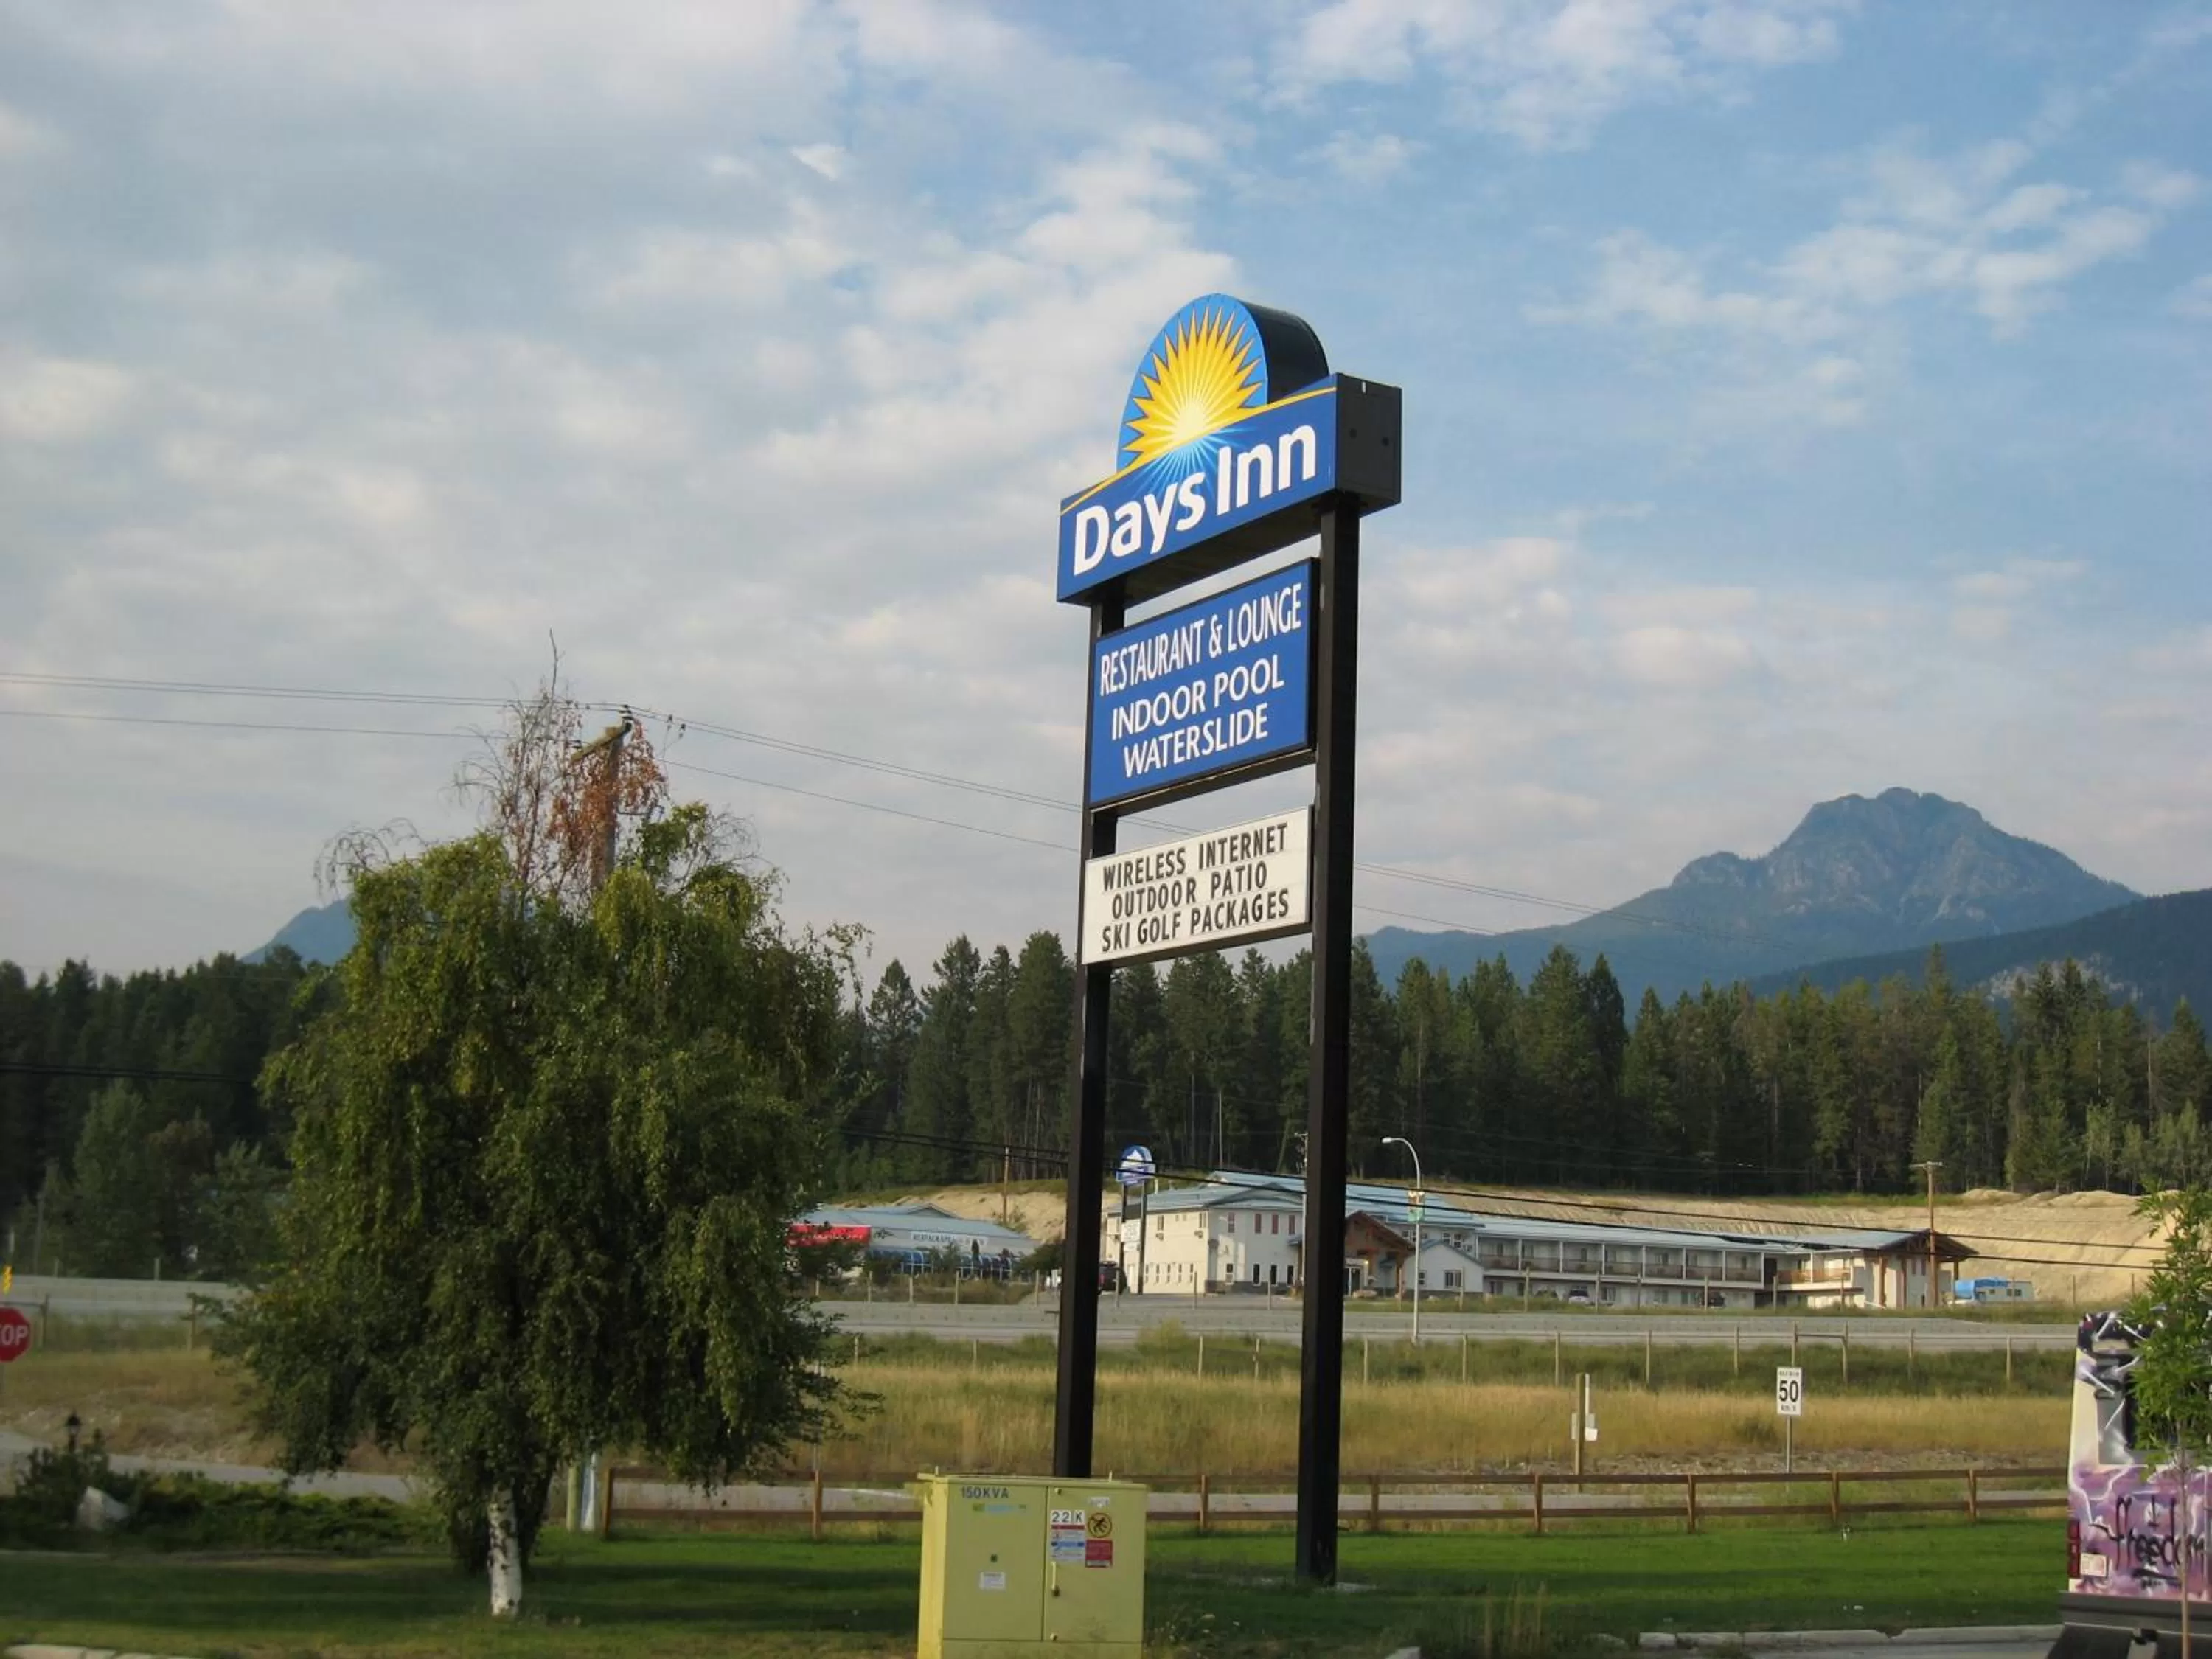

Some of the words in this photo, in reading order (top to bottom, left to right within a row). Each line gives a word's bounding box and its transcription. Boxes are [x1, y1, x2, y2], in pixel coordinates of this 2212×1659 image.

[1074, 472, 1206, 576] Days
[1216, 425, 1317, 515] Inn
[1100, 619, 1205, 696] RESTAURANT
[1208, 614, 1222, 658] &
[1228, 583, 1301, 653] LOUNGE
[1112, 680, 1206, 740] INDOOR
[1214, 654, 1284, 708] POOL
[1124, 703, 1268, 779] WATERSLIDE
[1103, 847, 1186, 891] WIRELESS
[1198, 822, 1288, 869] INTERNET
[1113, 877, 1196, 919] OUTDOOR
[1211, 861, 1267, 899] PATIO
[1102, 922, 1130, 952] SKI
[1138, 914, 1180, 945] GOLF
[1191, 888, 1289, 935] PACKAGES
[0, 1324, 28, 1346] OP
[1779, 1380, 1798, 1402] 50
